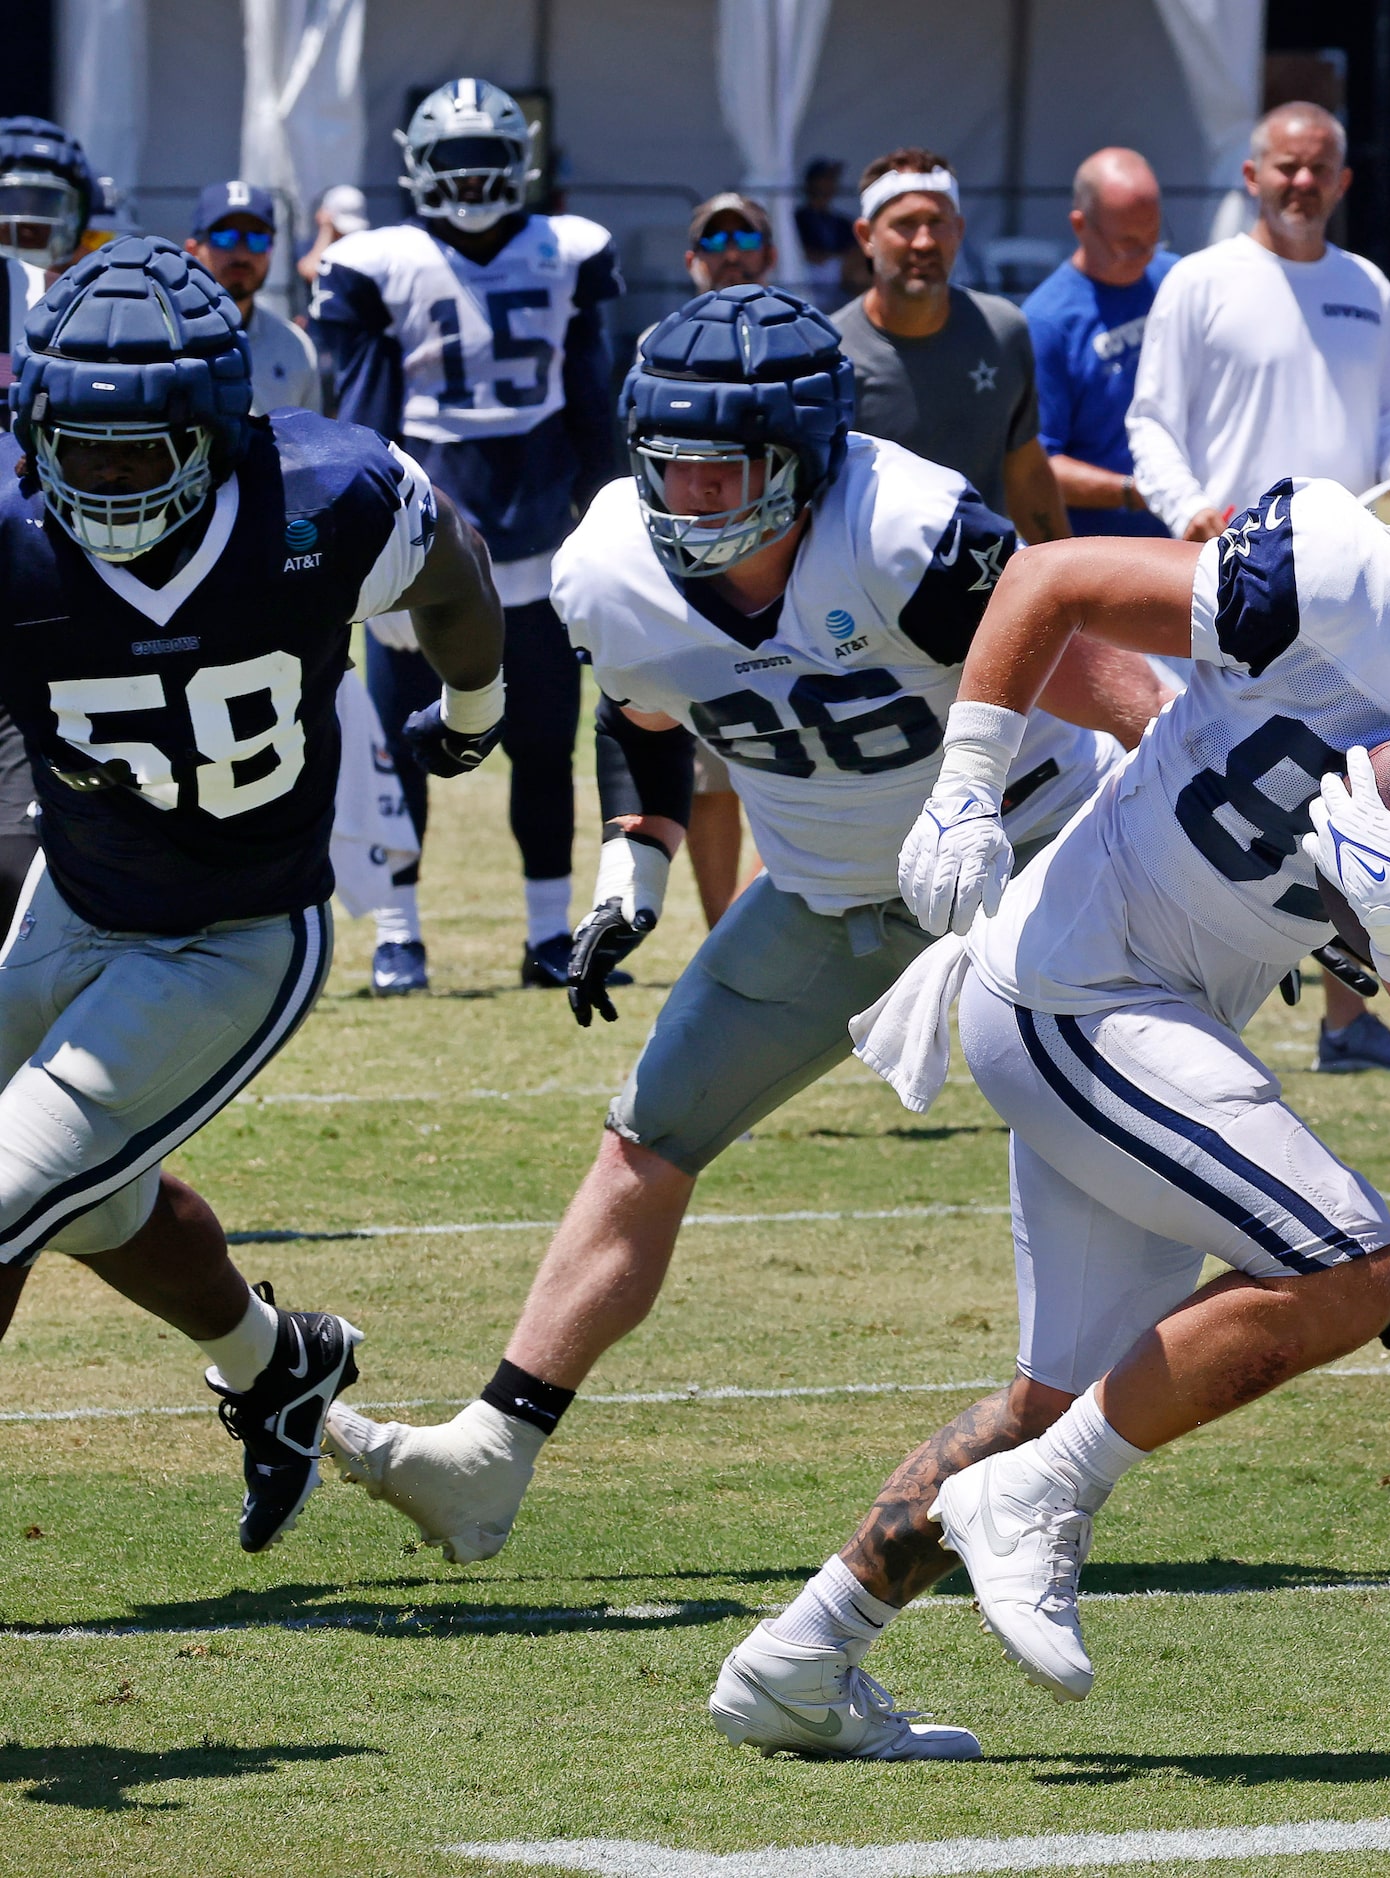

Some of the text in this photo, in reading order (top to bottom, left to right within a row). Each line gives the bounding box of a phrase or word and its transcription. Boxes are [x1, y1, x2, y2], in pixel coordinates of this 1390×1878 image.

[430, 290, 553, 409] 15
[283, 552, 323, 573] AT&T
[131, 636, 199, 656] COWBOYS
[834, 635, 870, 660] AT&T
[734, 655, 793, 675] COWBOYS
[47, 650, 306, 820] 58
[1175, 713, 1346, 924] 8
